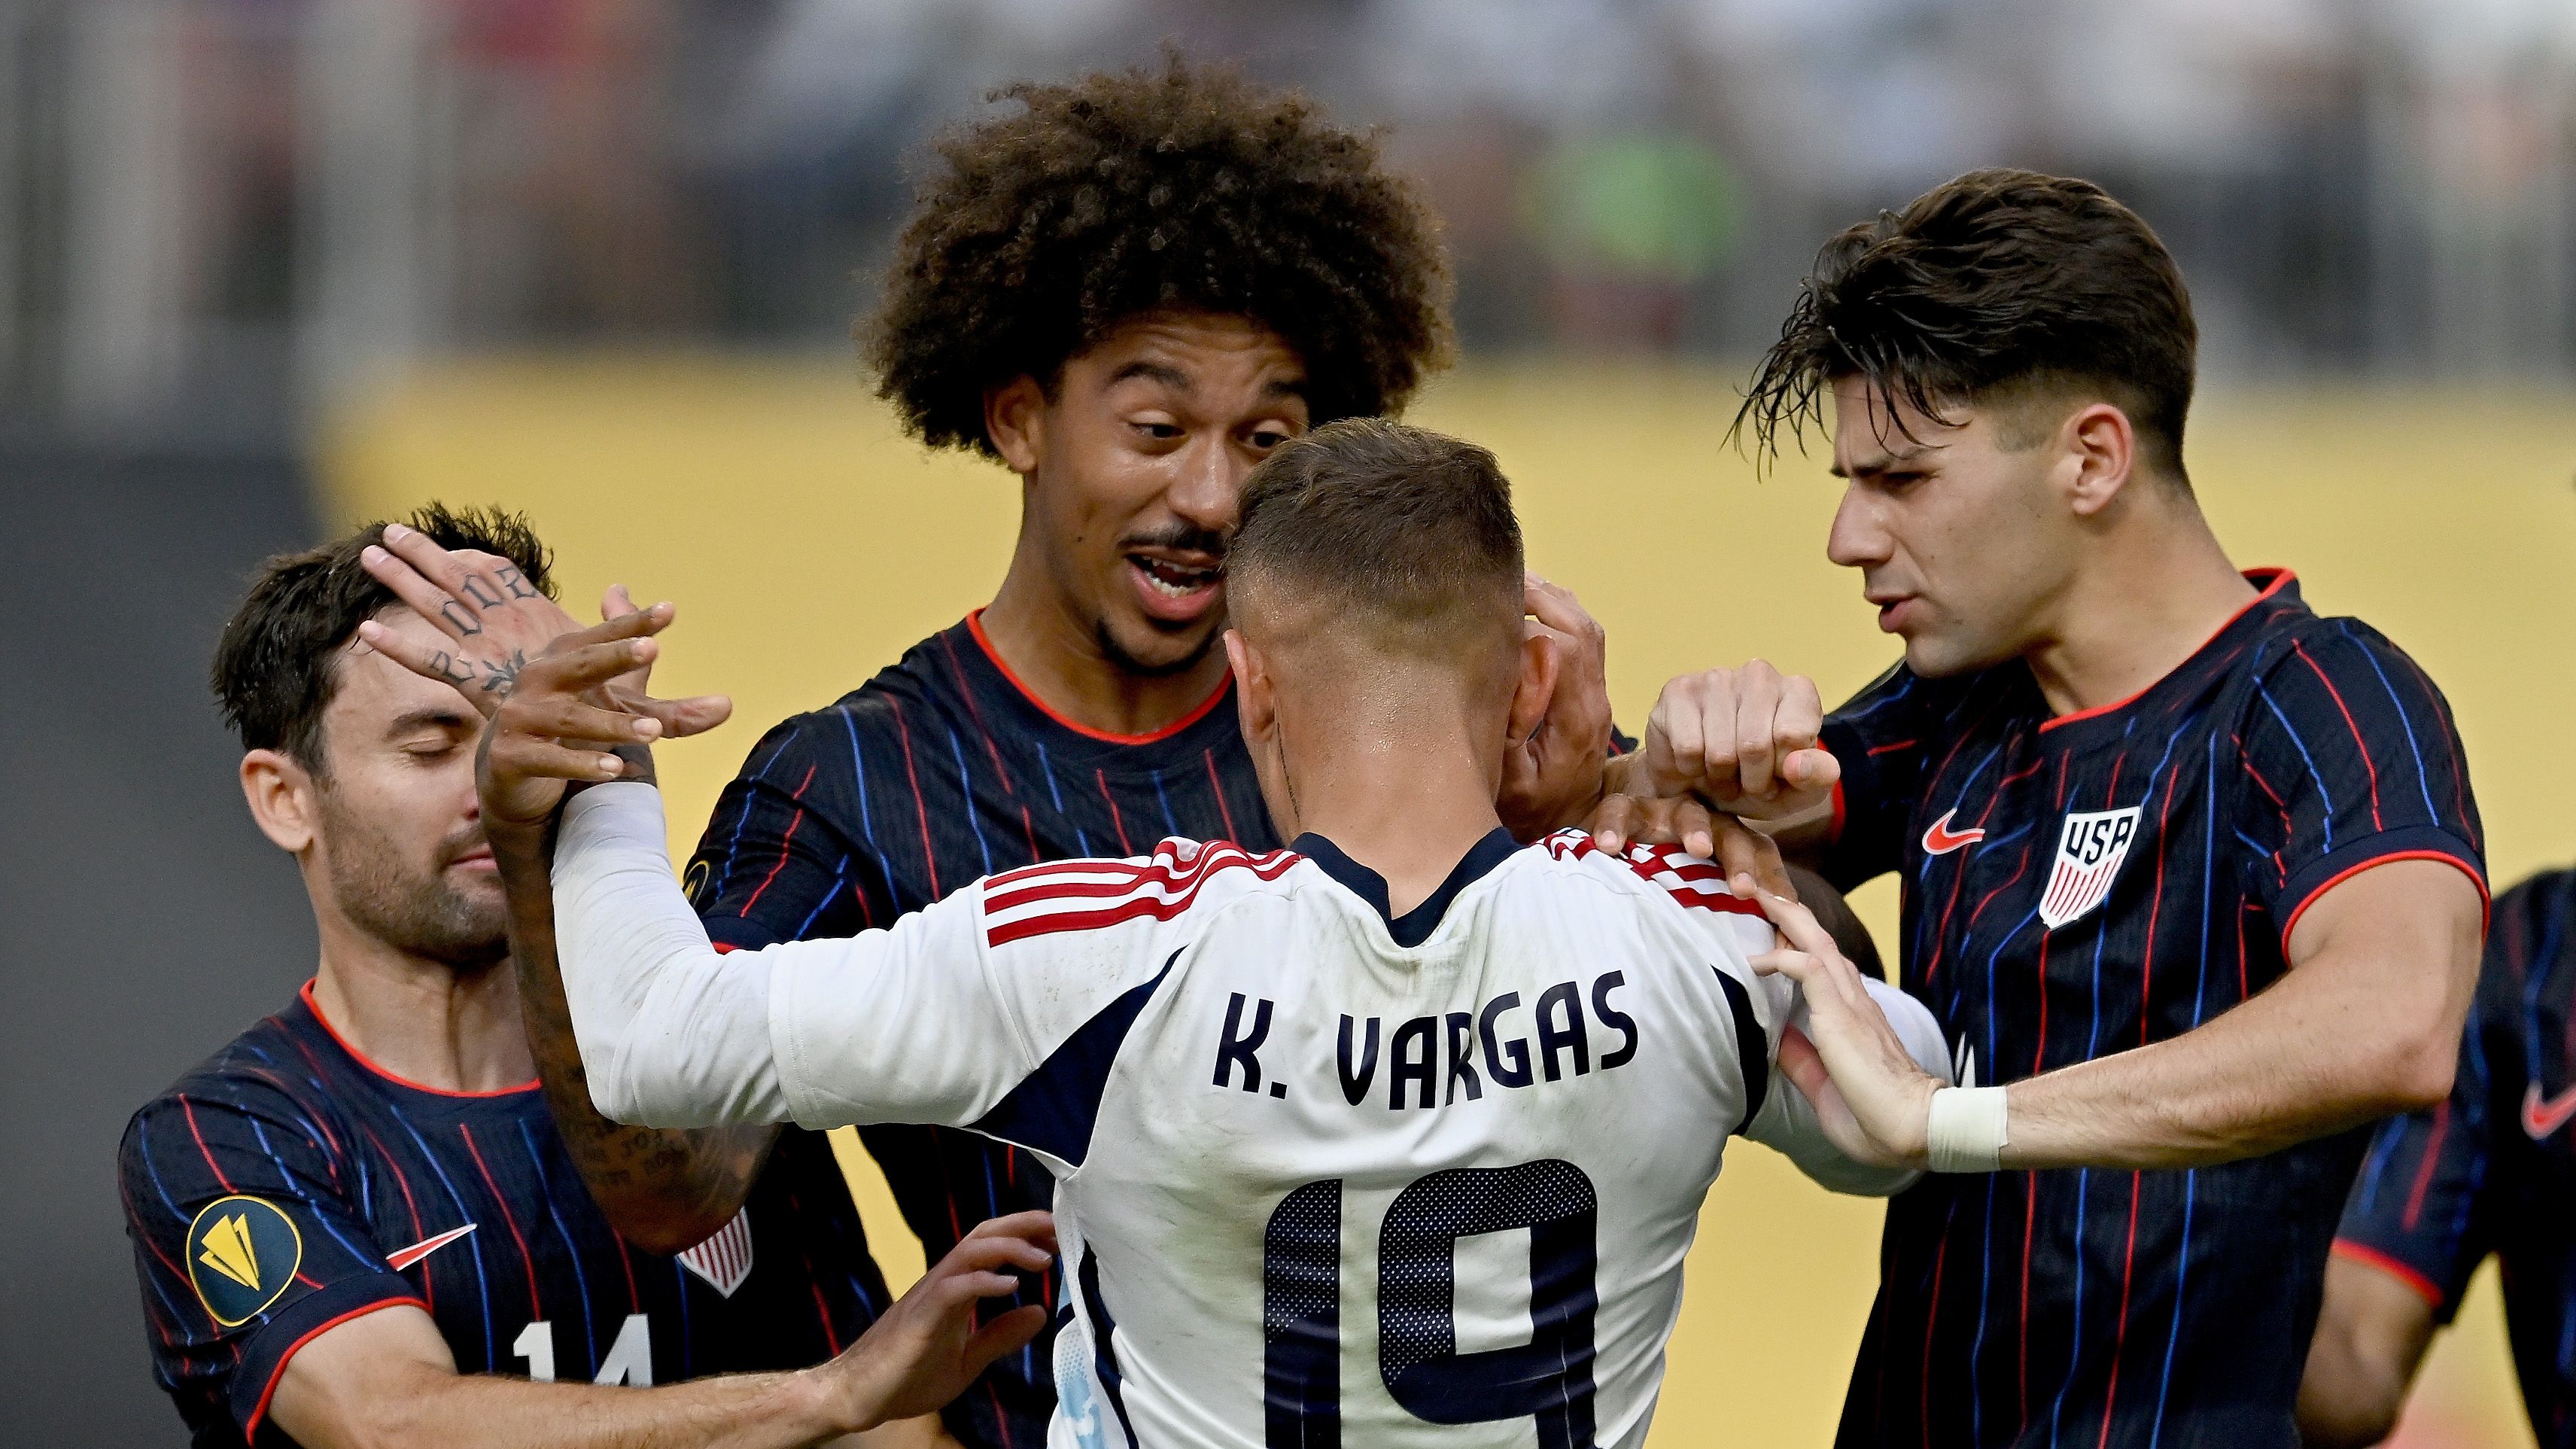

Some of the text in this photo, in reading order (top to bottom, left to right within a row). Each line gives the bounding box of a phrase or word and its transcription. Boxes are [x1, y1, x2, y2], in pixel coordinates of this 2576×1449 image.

[2065, 814, 2134, 866] USA
[1212, 970, 1639, 1110] K. VARGAS
[512, 1314, 652, 1388] 14
[1263, 1158, 1598, 1449] 19
